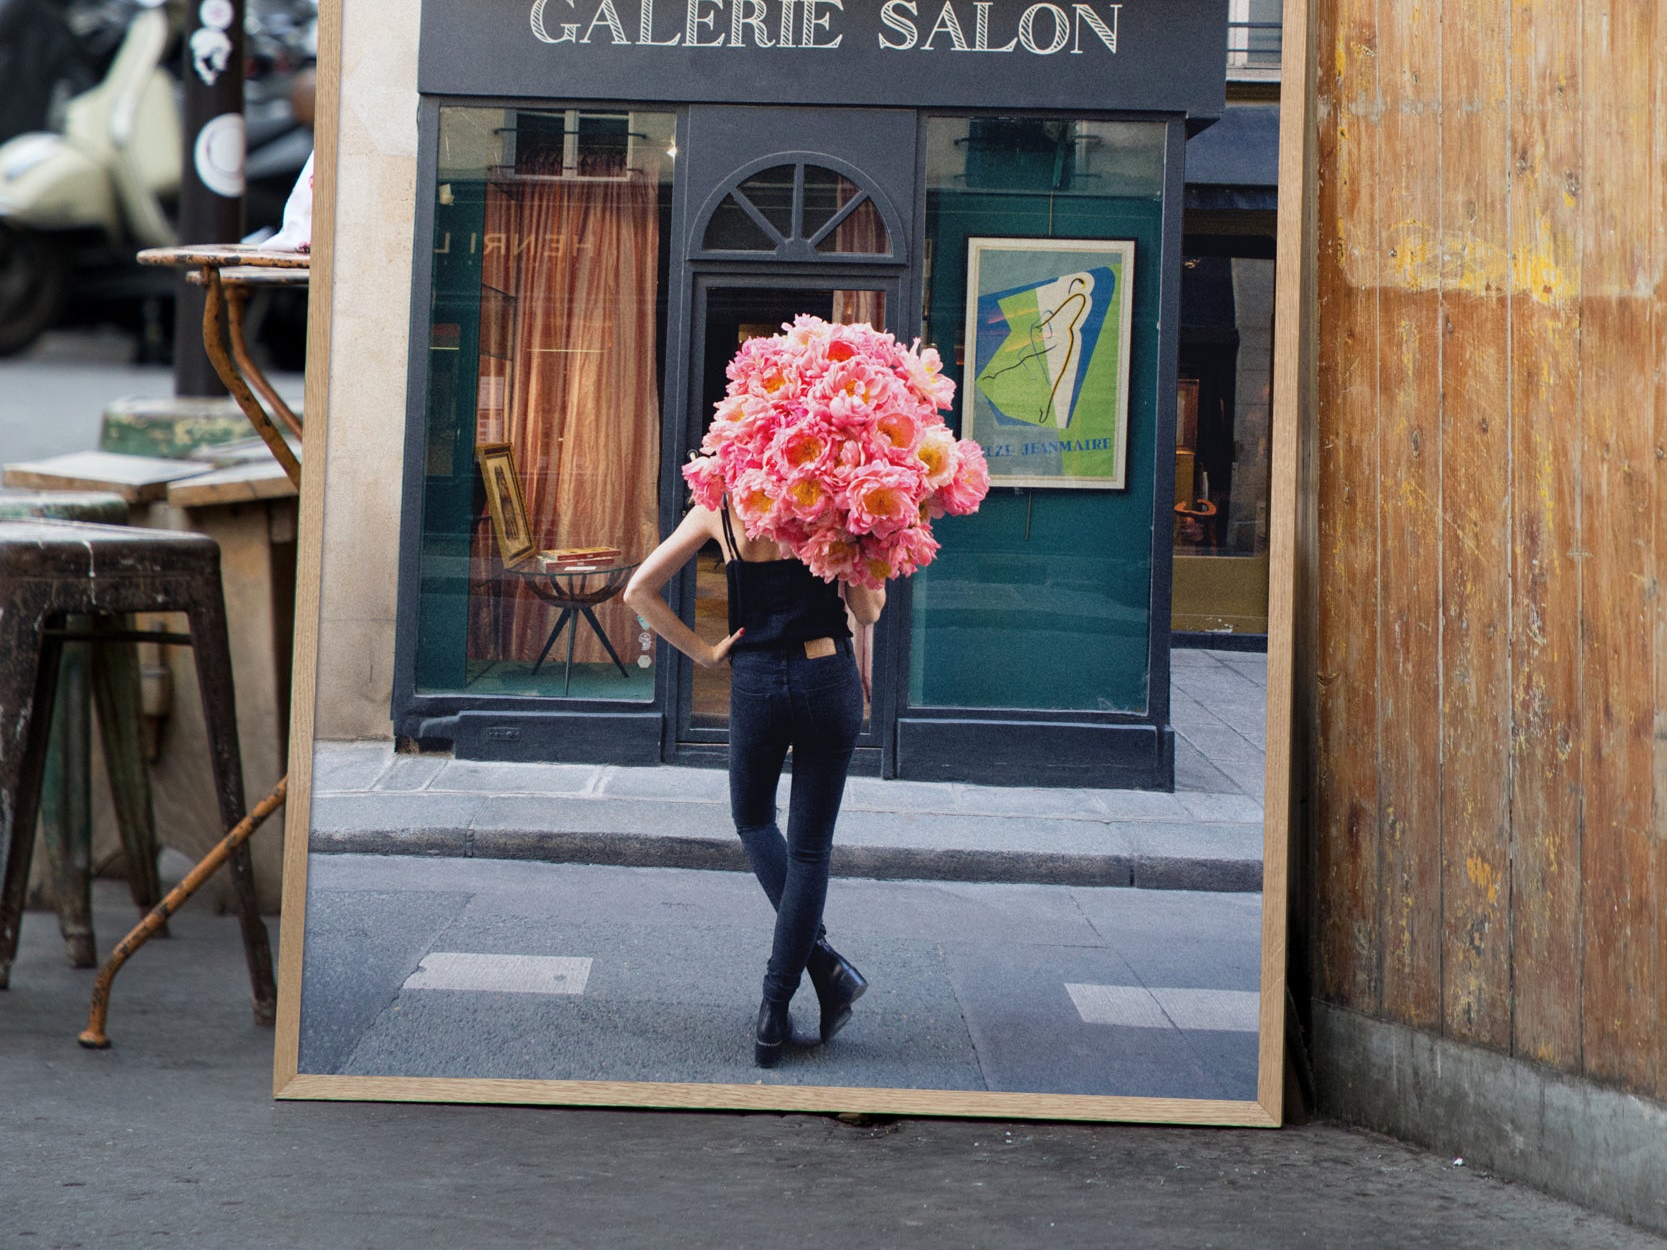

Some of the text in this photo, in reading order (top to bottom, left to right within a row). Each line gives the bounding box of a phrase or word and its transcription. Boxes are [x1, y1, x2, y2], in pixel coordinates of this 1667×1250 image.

[878, 0, 1123, 55] SALON
[980, 438, 1111, 458] IZI JEANMAIRE
